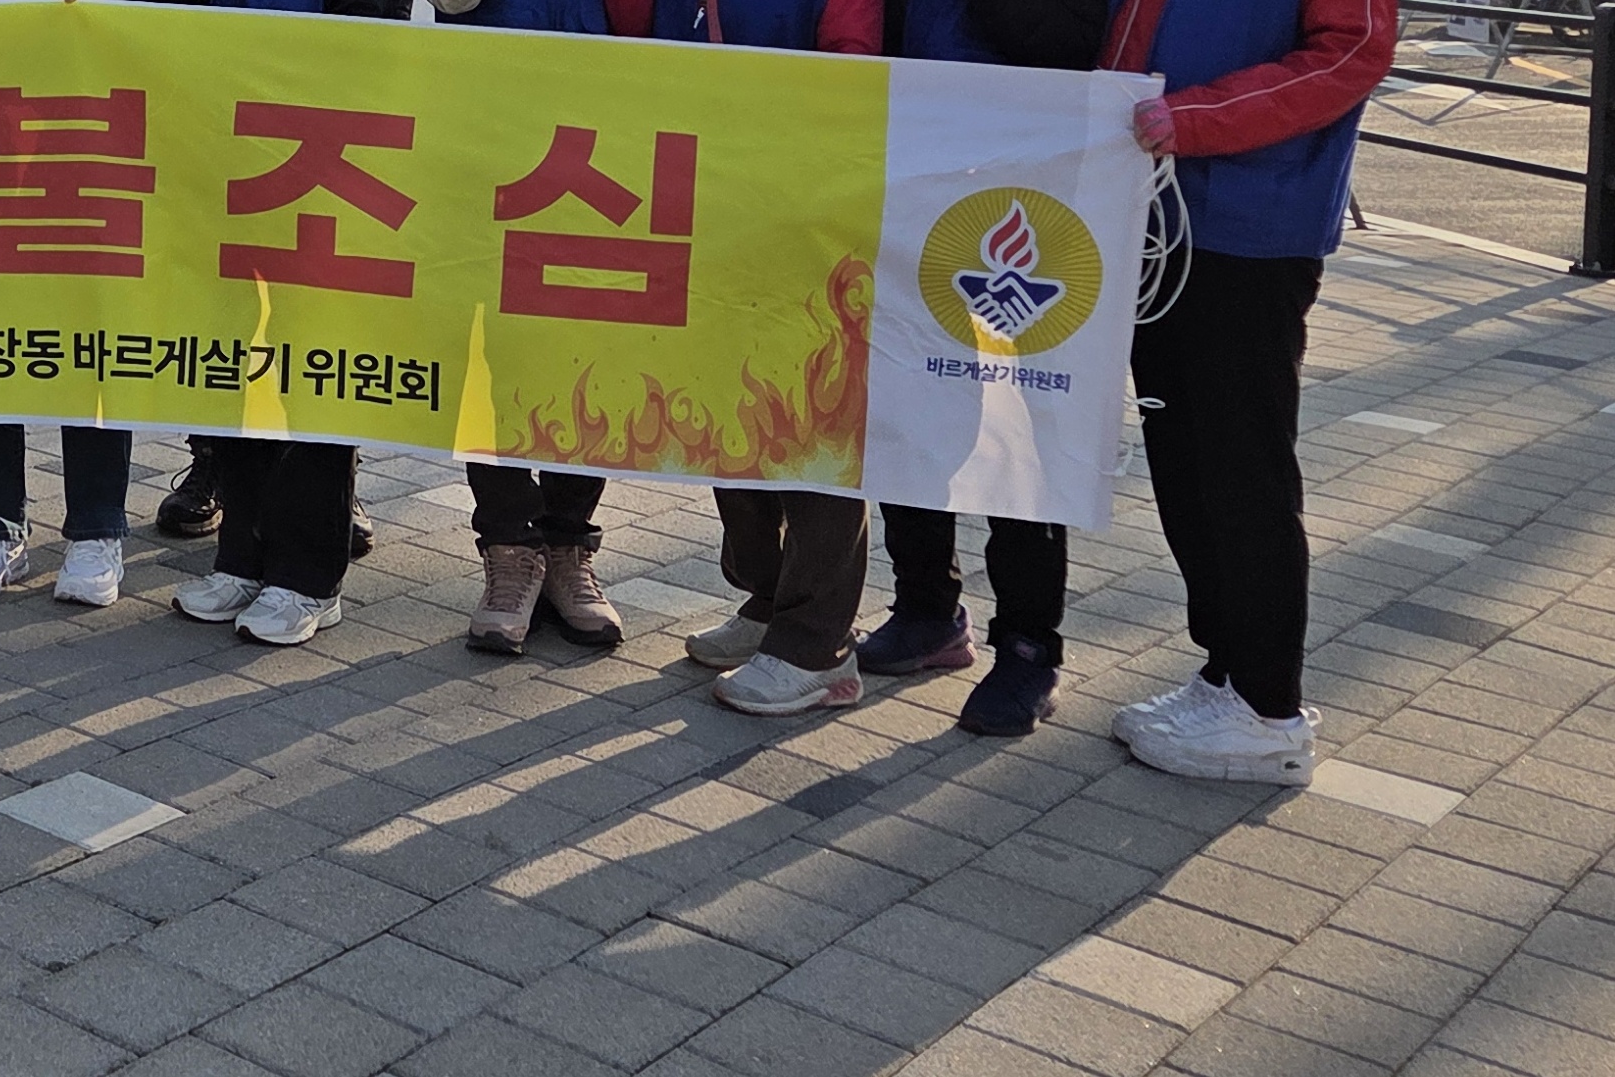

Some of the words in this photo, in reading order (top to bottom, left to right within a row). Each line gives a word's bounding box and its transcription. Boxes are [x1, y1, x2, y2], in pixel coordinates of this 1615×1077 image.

[73, 331, 292, 395] 바르게살기
[302, 347, 441, 412] 위원회
[926, 356, 1072, 394] 바르게살기위원회
